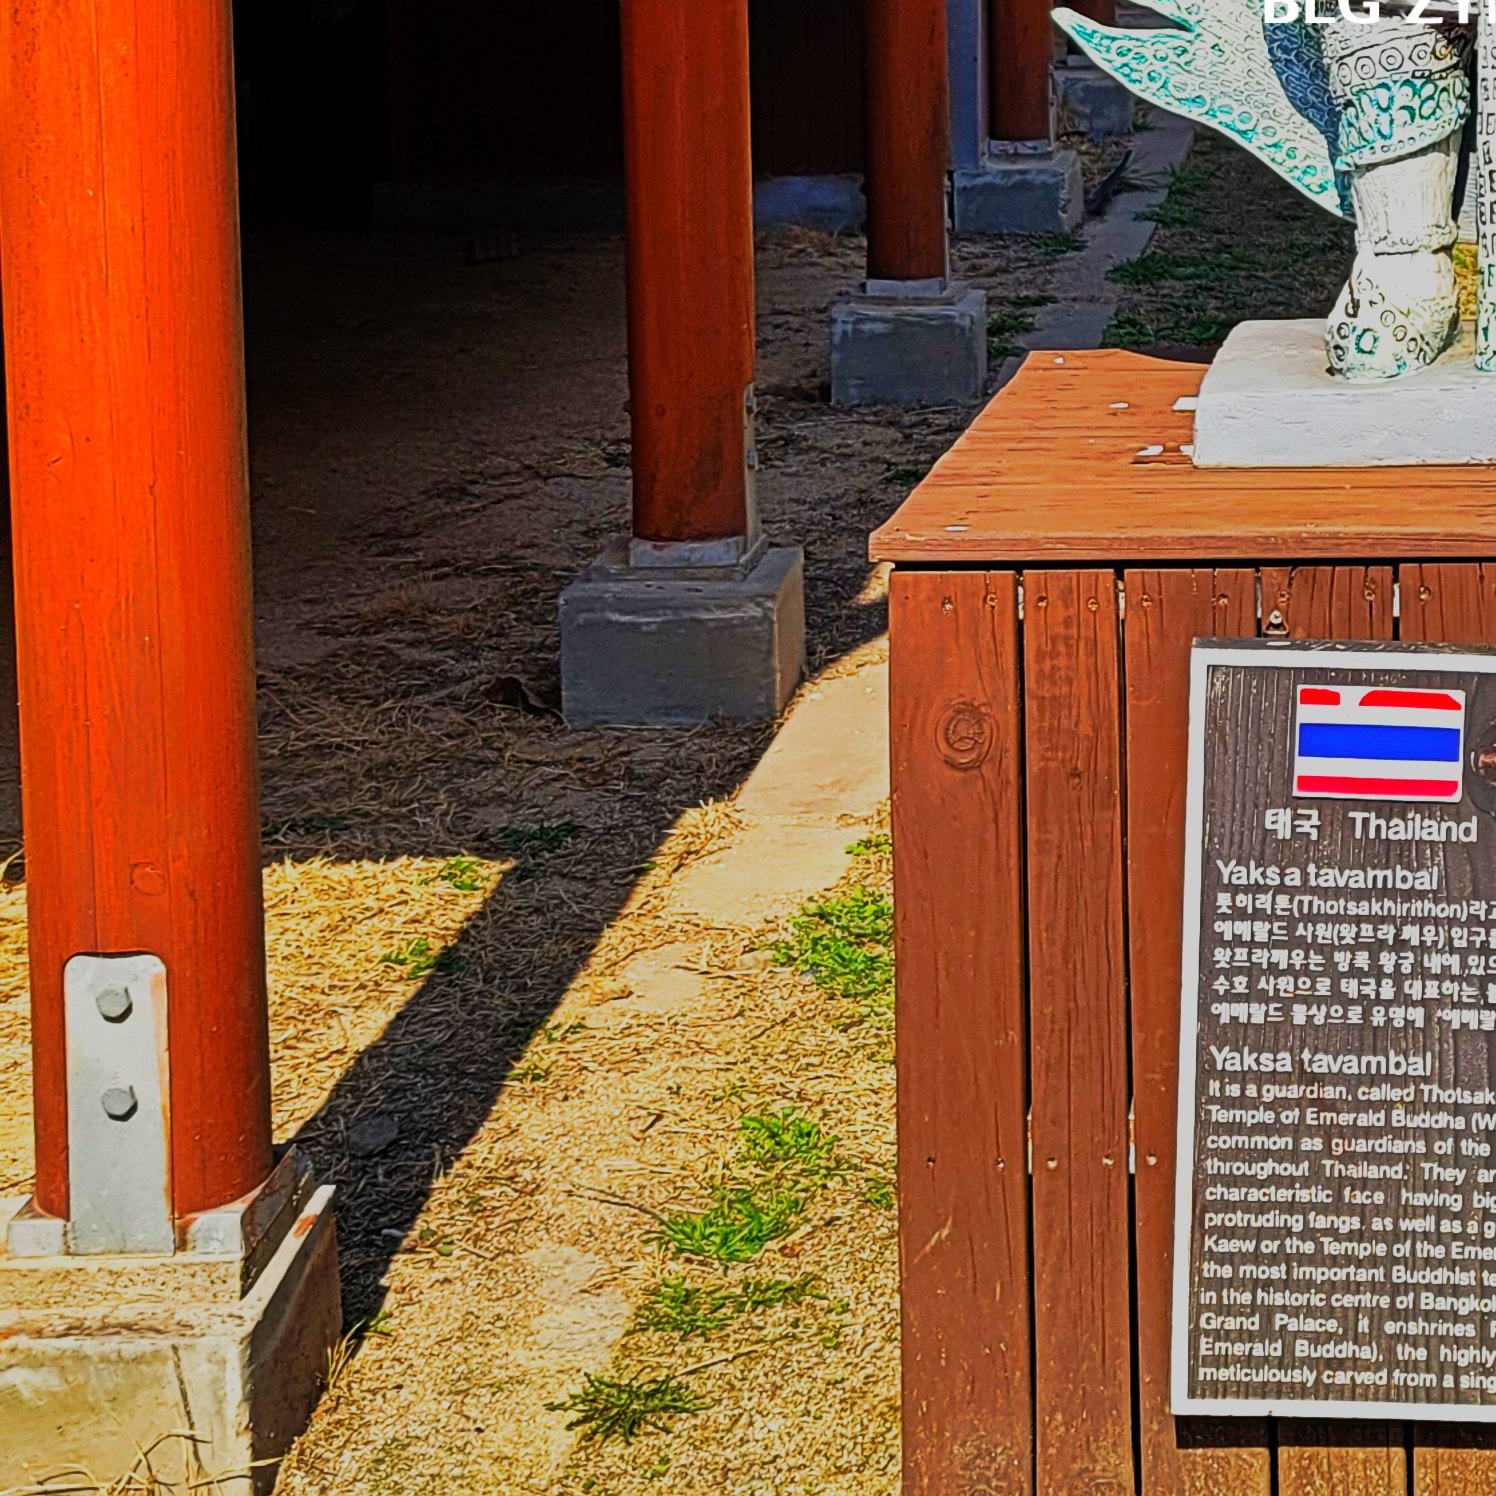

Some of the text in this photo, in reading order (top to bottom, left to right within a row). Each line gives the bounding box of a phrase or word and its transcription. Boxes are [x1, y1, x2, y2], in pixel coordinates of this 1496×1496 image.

[1264, 807, 1478, 842] 태국 Thailand
[1216, 859, 1439, 890] Yaksa tavambal
[1333, 951, 1371, 972] 방콕
[1378, 951, 1415, 974] 왕궁
[1423, 951, 1460, 976] 내에
[1211, 975, 1250, 996] 수호
[1257, 975, 1332, 997] 사원으로
[1340, 978, 1397, 1000] 태국을
[1290, 1003, 1363, 1025] 불상으로
[1209, 1045, 1432, 1076] Yaksa tavambal
[1209, 1079, 1221, 1097] It
[1225, 1078, 1241, 1097] is
[1245, 1084, 1258, 1098] a
[1357, 1083, 1415, 1102] called
[1206, 1104, 1276, 1127] Temple
[1280, 1107, 1300, 1124] of
[1306, 1107, 1386, 1127] Emerald
[1391, 1109, 1466, 1130] Buddha
[1206, 1135, 1293, 1150] common
[1300, 1137, 1323, 1151] as
[1331, 1134, 1427, 1155] guardians
[1433, 1137, 1454, 1155] of
[1460, 1138, 1491, 1157] the
[1205, 1157, 1309, 1180] throughout
[1420, 1162, 1467, 1186] They
[1205, 1182, 1333, 1203] characteristic
[1343, 1186, 1385, 1205] face
[1401, 1188, 1463, 1212] having
[1204, 1209, 1304, 1233] protruding
[1371, 1217, 1393, 1231] as
[1399, 1215, 1436, 1233] well
[1439, 1219, 1463, 1234] as
[1466, 1220, 1479, 1235] a
[1204, 1235, 1257, 1253] Kaew
[1260, 1239, 1281, 1254] or
[1284, 1236, 1315, 1254] the
[1319, 1237, 1388, 1260] Temple
[1392, 1239, 1412, 1258] of
[1415, 1240, 1446, 1259] the
[1203, 1260, 1233, 1279] the
[1239, 1263, 1287, 1280] most
[1292, 1262, 1385, 1284] important
[1391, 1265, 1476, 1286] Buddhist
[1200, 1287, 1217, 1305] in
[1222, 1288, 1253, 1305] the
[1256, 1287, 1326, 1307] historic
[1331, 1292, 1391, 1309] centre
[1395, 1292, 1415, 1309] of
[1199, 1312, 1260, 1331] Grand
[1275, 1313, 1343, 1334] Palace,
[1357, 1313, 1370, 1333] it
[1383, 1317, 1476, 1337] enshrines
[1199, 1335, 1282, 1357] Emerald
[1295, 1339, 1384, 1362] Buddha),
[1396, 1343, 1428, 1361] the
[1198, 1363, 1317, 1387] meticulously
[1322, 1368, 1388, 1385] carved
[1392, 1368, 1437, 1387] from
[1442, 1374, 1455, 1388] a
